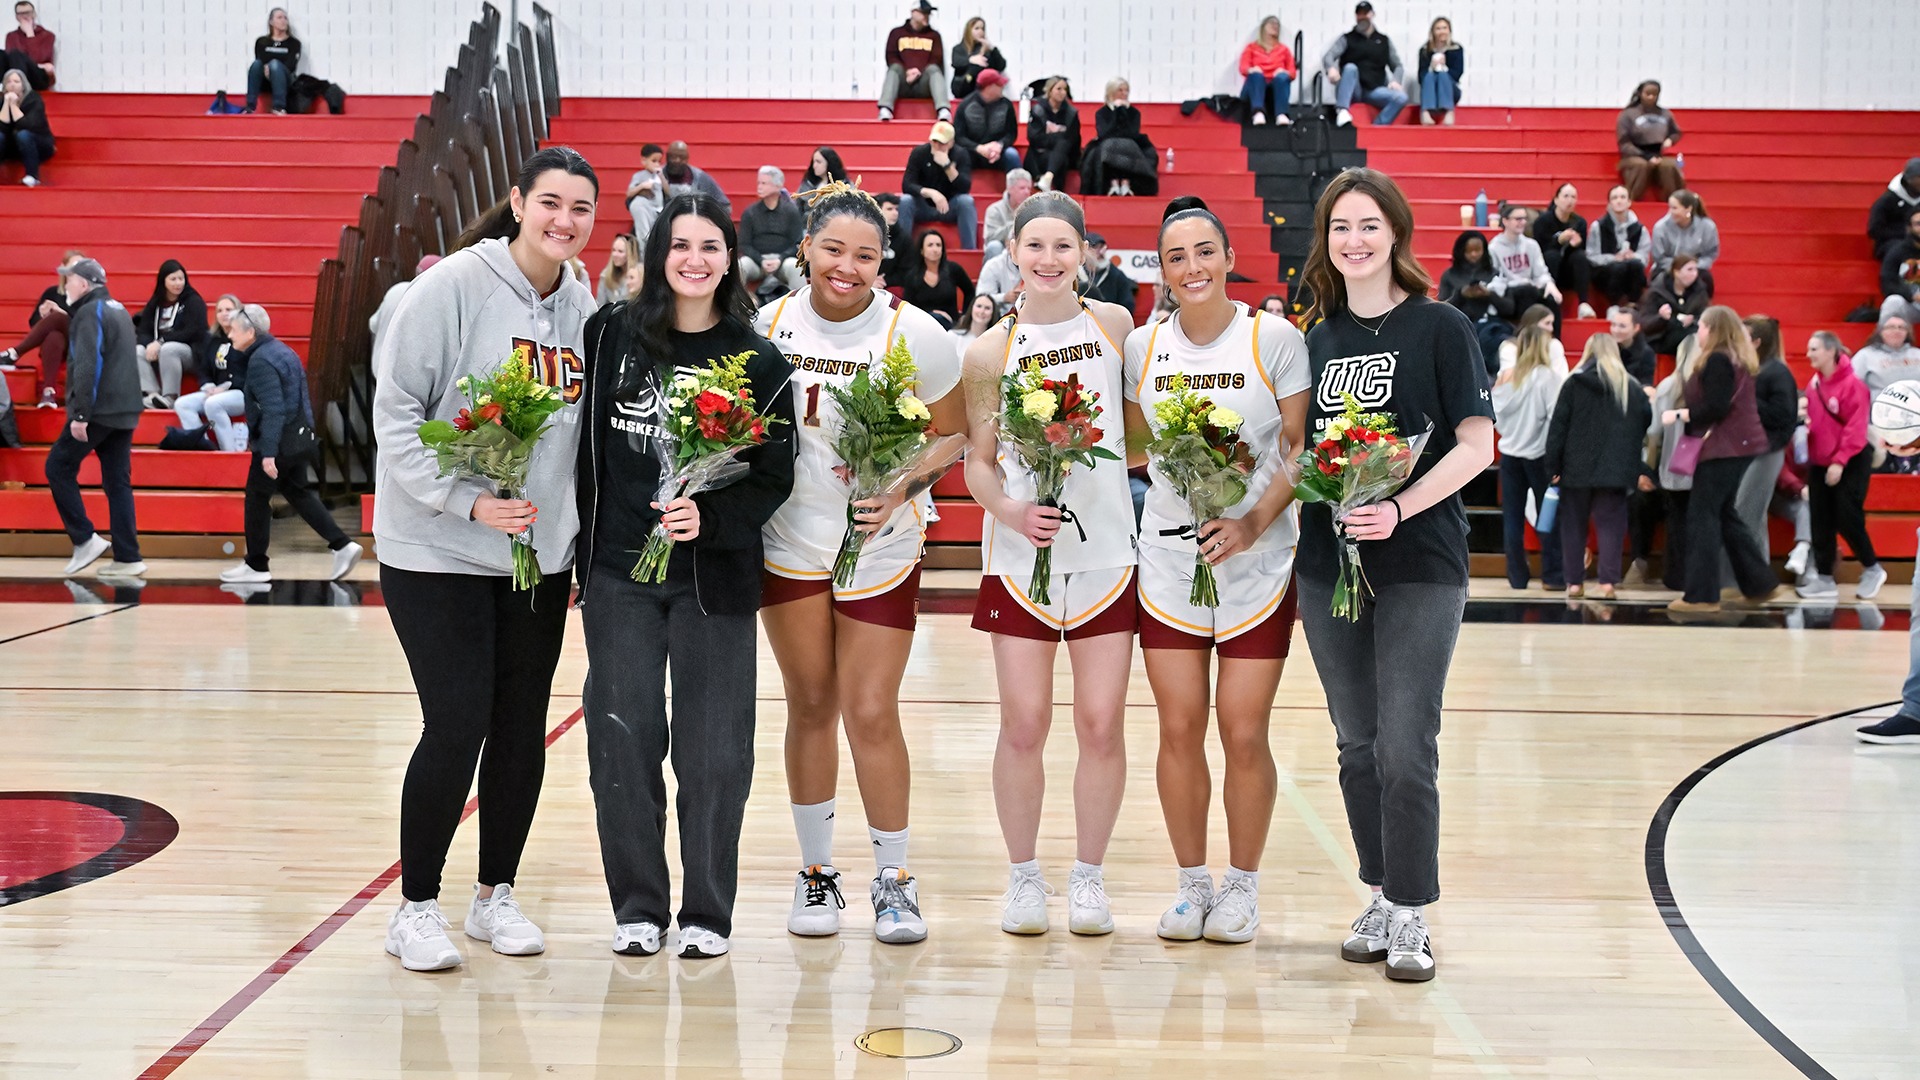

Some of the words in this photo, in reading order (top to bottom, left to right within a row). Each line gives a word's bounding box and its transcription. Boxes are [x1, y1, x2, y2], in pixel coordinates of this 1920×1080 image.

[783, 353, 869, 376] RSINUS
[1316, 351, 1396, 412] UC
[803, 383, 821, 427] 1
